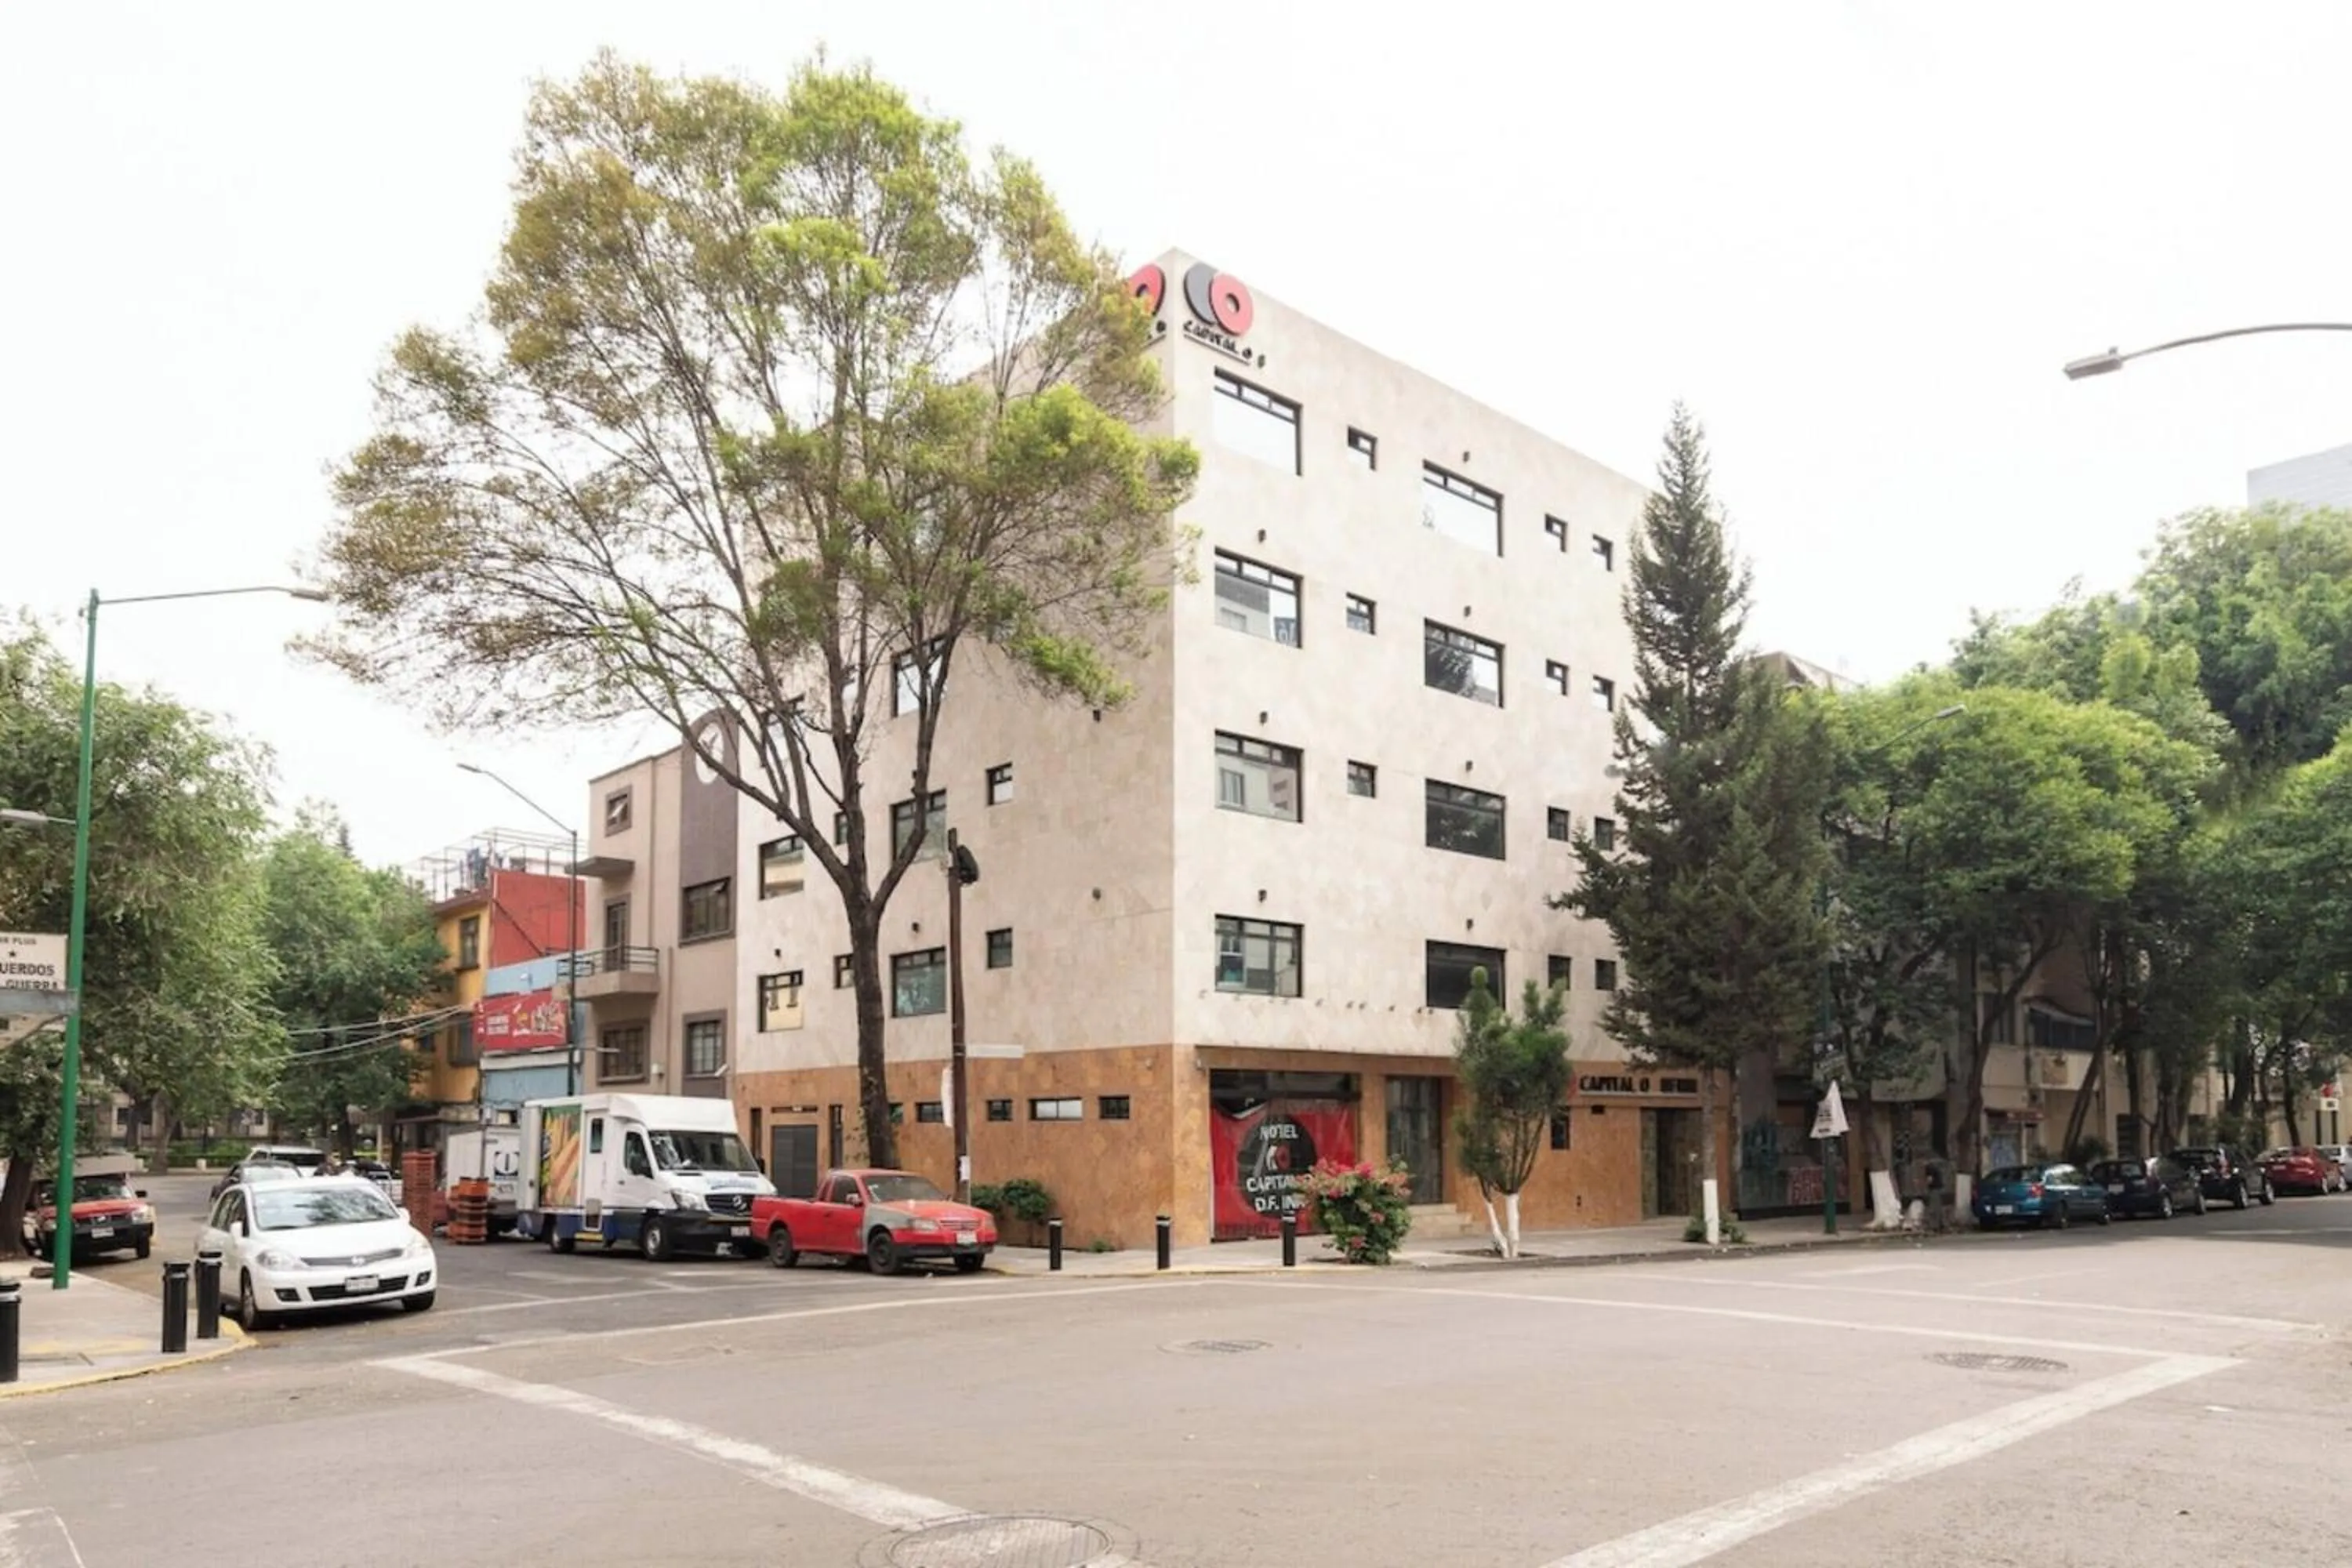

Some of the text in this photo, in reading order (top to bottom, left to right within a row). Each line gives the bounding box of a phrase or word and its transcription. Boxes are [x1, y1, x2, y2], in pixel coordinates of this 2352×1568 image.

[1579, 1075, 1636, 1092] CAPITAL
[1260, 1123, 1298, 1140] HOTEL
[1246, 1174, 1298, 1192] CAPITA
[1281, 1193, 1306, 1210] IN
